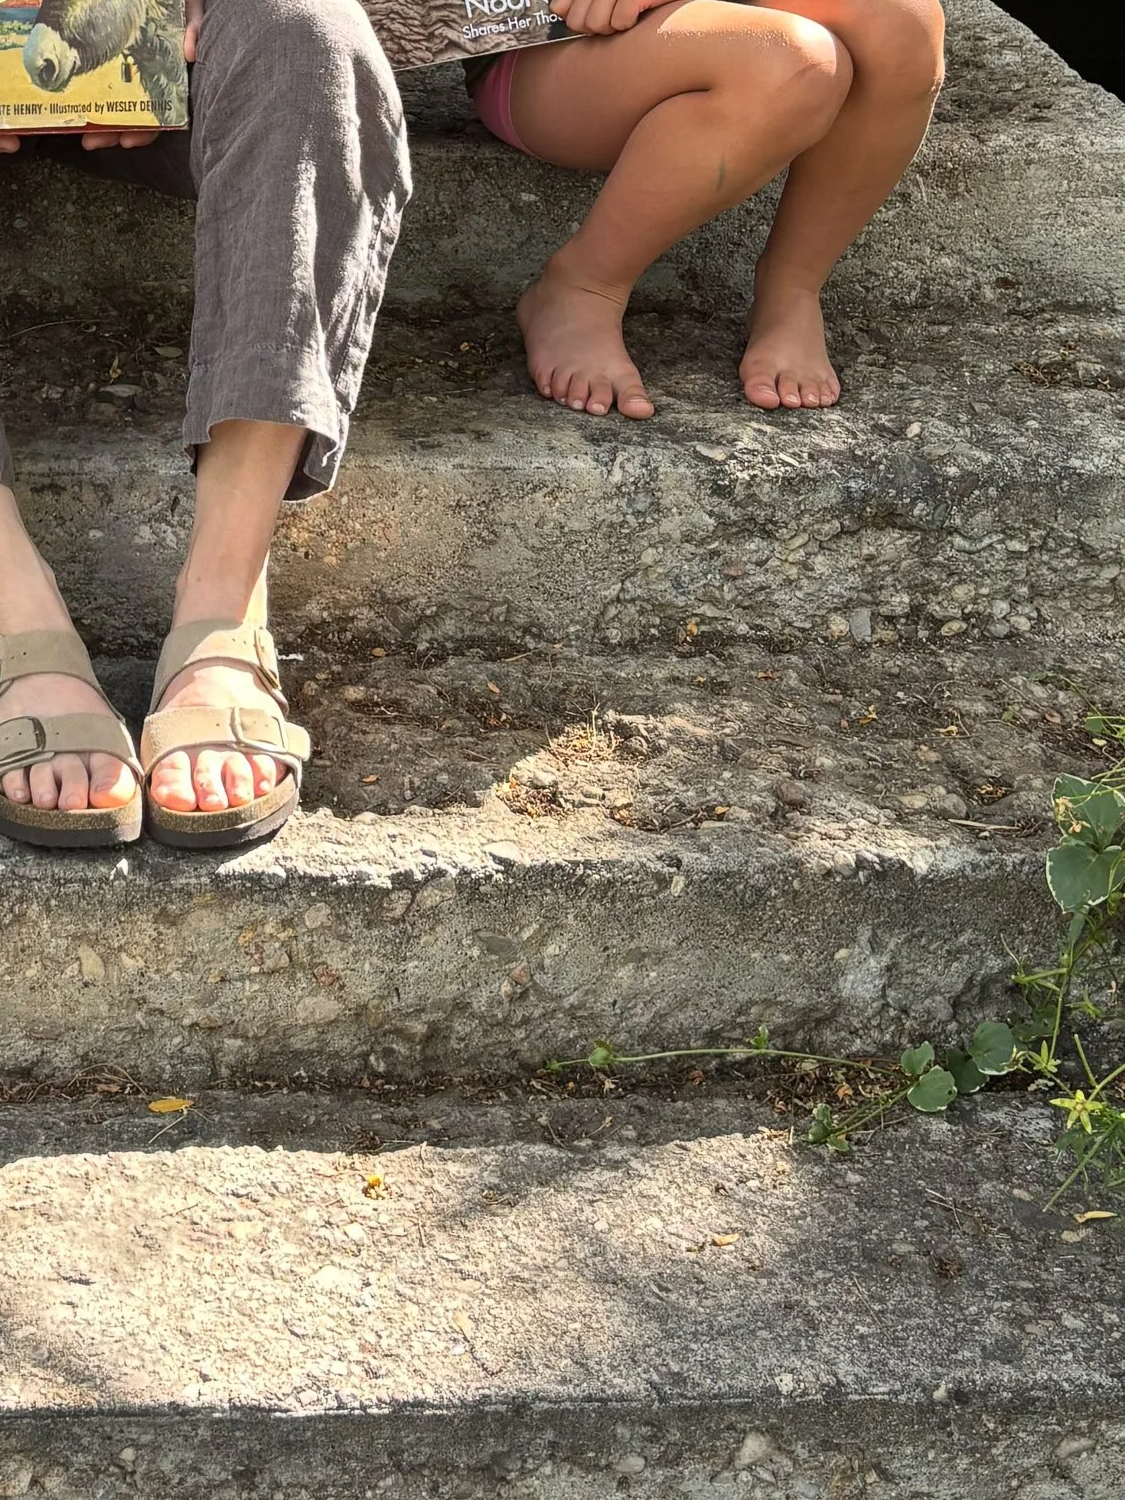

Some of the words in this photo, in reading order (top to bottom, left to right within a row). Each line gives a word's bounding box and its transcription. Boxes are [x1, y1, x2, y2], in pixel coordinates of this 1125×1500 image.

[462, 24, 505, 39] Shares
[508, 16, 531, 30] Her
[13, 103, 43, 116] HENRY
[49, 102, 92, 114] Illustrated
[94, 102, 105, 115] by
[106, 100, 137, 113] WESLEY
[139, 99, 173, 112] DENNIS
